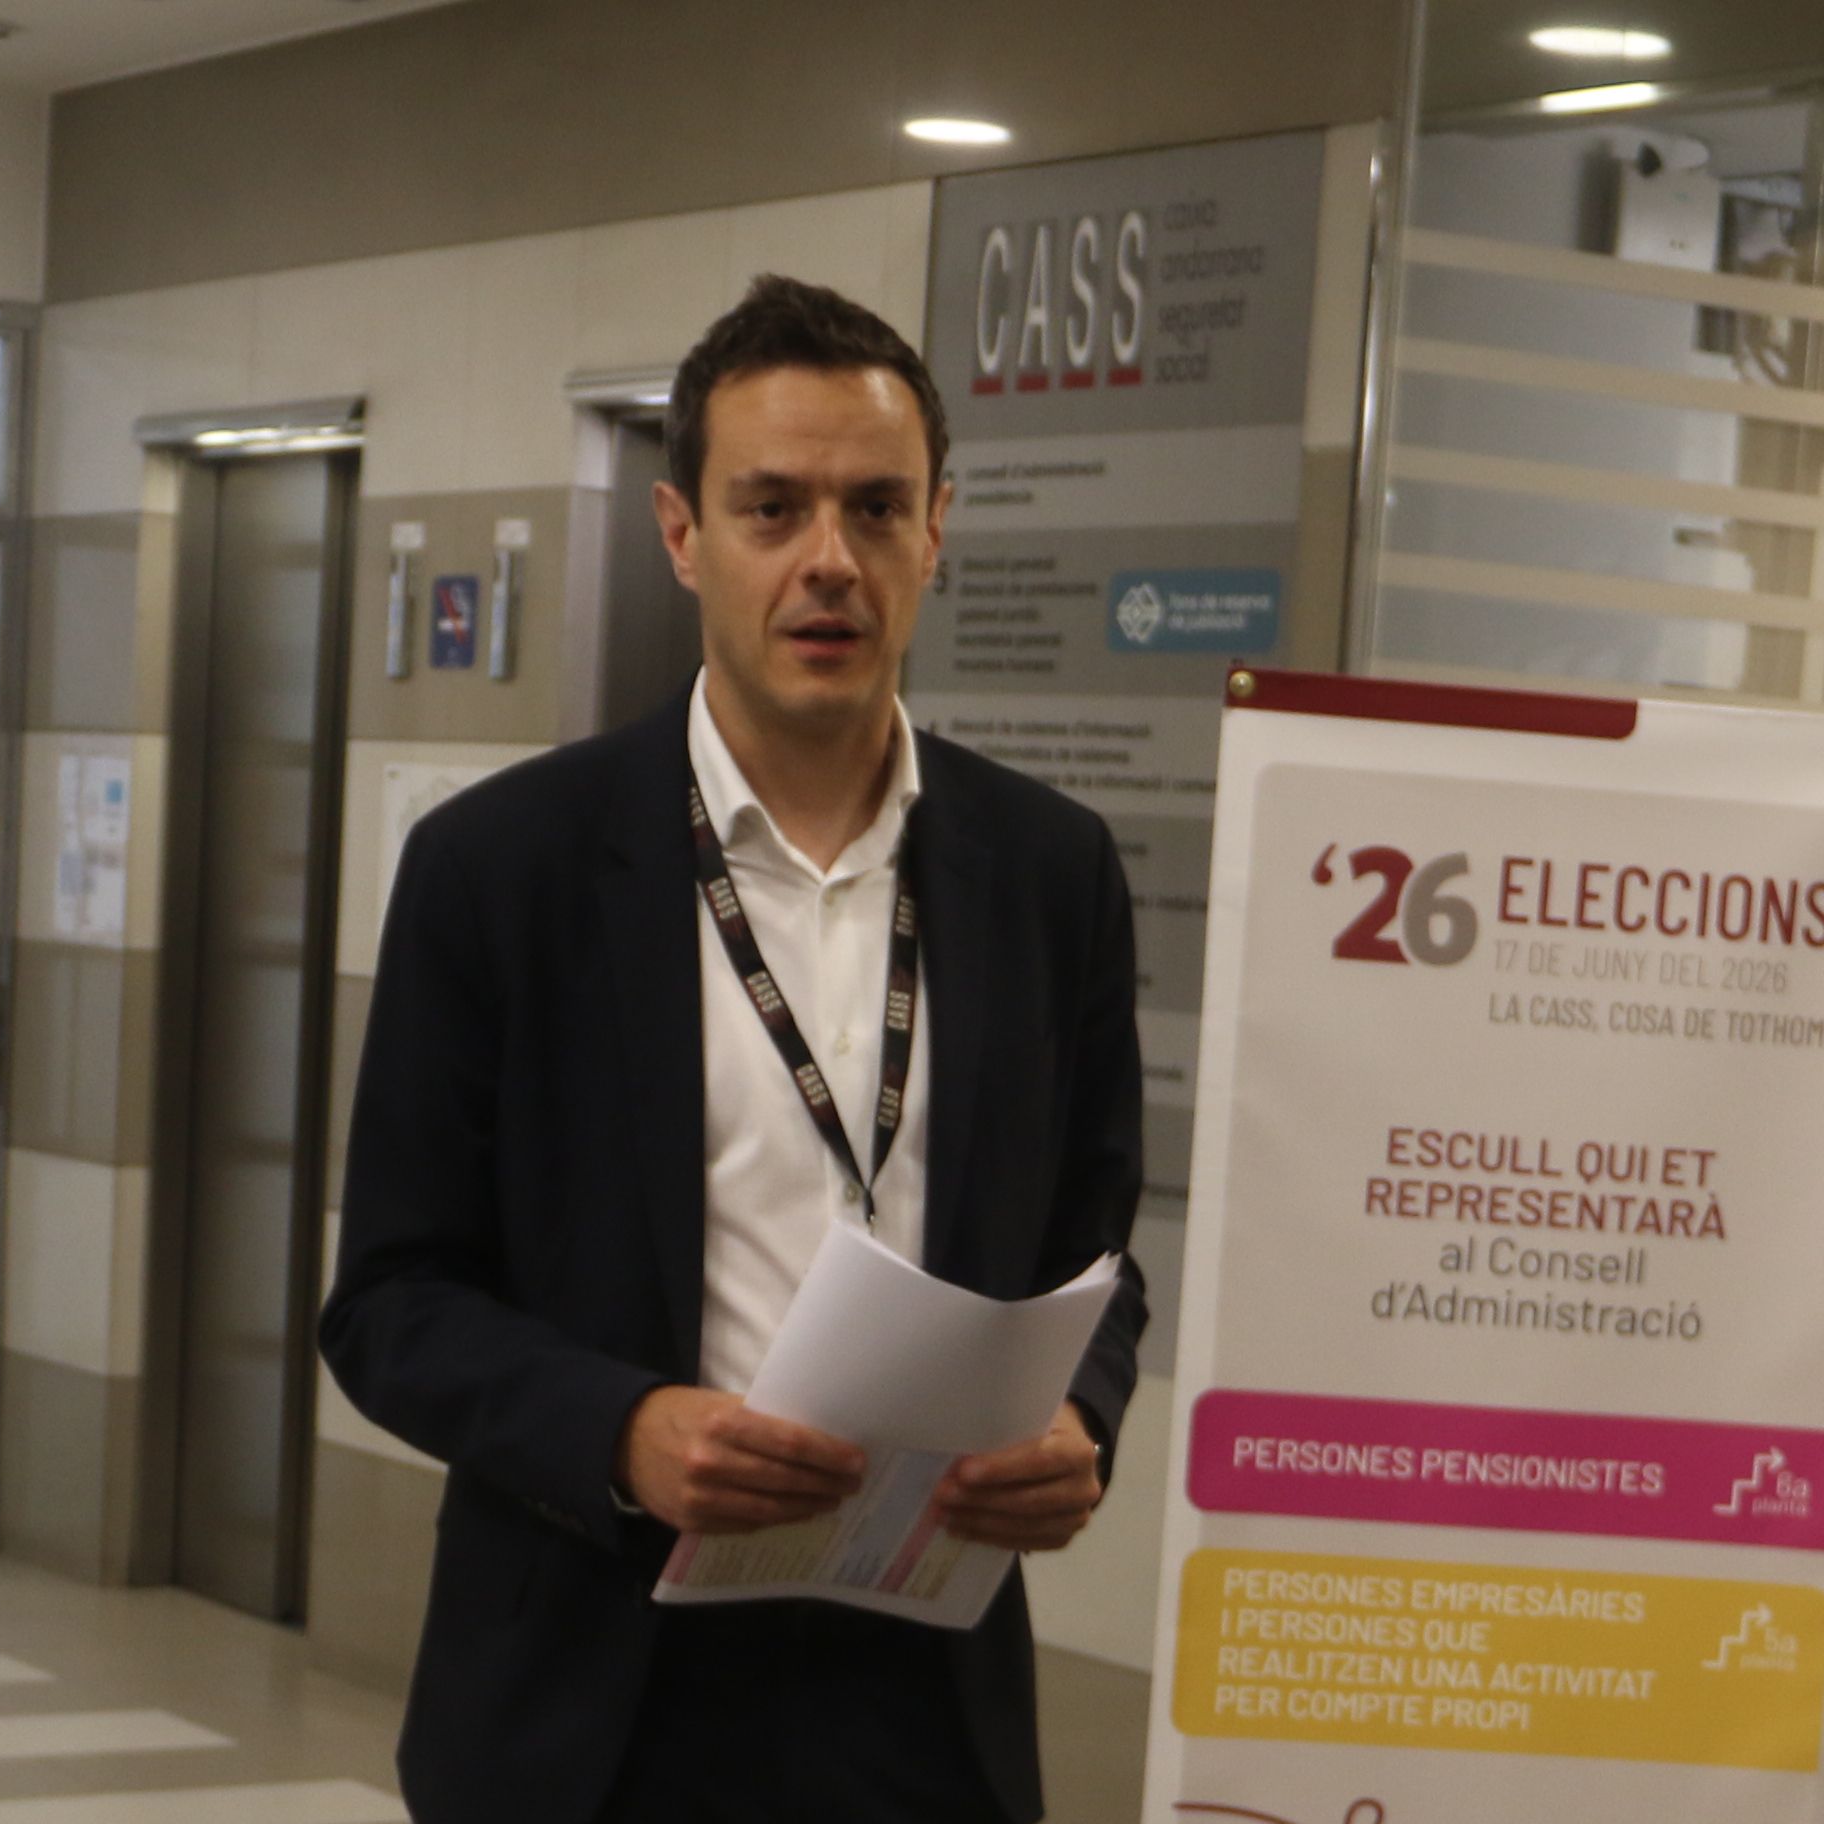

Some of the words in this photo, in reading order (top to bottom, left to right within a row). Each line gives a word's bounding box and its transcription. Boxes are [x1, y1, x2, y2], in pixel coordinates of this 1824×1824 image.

[976, 210, 1149, 377] CASS
[1493, 939, 1521, 973] 17
[1526, 941, 1563, 977] DE
[1572, 943, 1651, 985] JUNY
[1658, 949, 1711, 989] DEL
[1721, 953, 1790, 995] 2026
[1487, 992, 1522, 1026] LA
[1528, 995, 1601, 1035] CASS,
[1608, 999, 1675, 1037] COSA
[1682, 1005, 1718, 1042] DE
[1386, 1126, 1564, 1180] ESCULL
[1575, 1138, 1648, 1191] QUI
[1661, 1147, 1718, 1189] ET
[1365, 1178, 1728, 1242] REPRESENTARÀ
[1438, 1237, 1475, 1275] al
[1487, 1238, 1646, 1286] Consell
[1370, 1282, 1703, 1340] d'Administració
[1232, 1435, 1413, 1479] PERSONES
[1420, 1450, 1665, 1497] PENSIONISTES
[1776, 1471, 1810, 1499] 6a
[1223, 1567, 1404, 1610] PERSONES
[1410, 1570, 1646, 1625] EMPRESÀRIES
[1236, 1608, 1417, 1650] PERSONES
[1424, 1621, 1491, 1656] QUE
[1218, 1647, 1405, 1688] REALITZEN
[1410, 1661, 1483, 1693] UNA
[1489, 1664, 1657, 1702] ACTIVITAT
[1214, 1684, 1281, 1720] PER
[1287, 1688, 1424, 1728] COMPTE
[1431, 1697, 1531, 1733] PROPI
